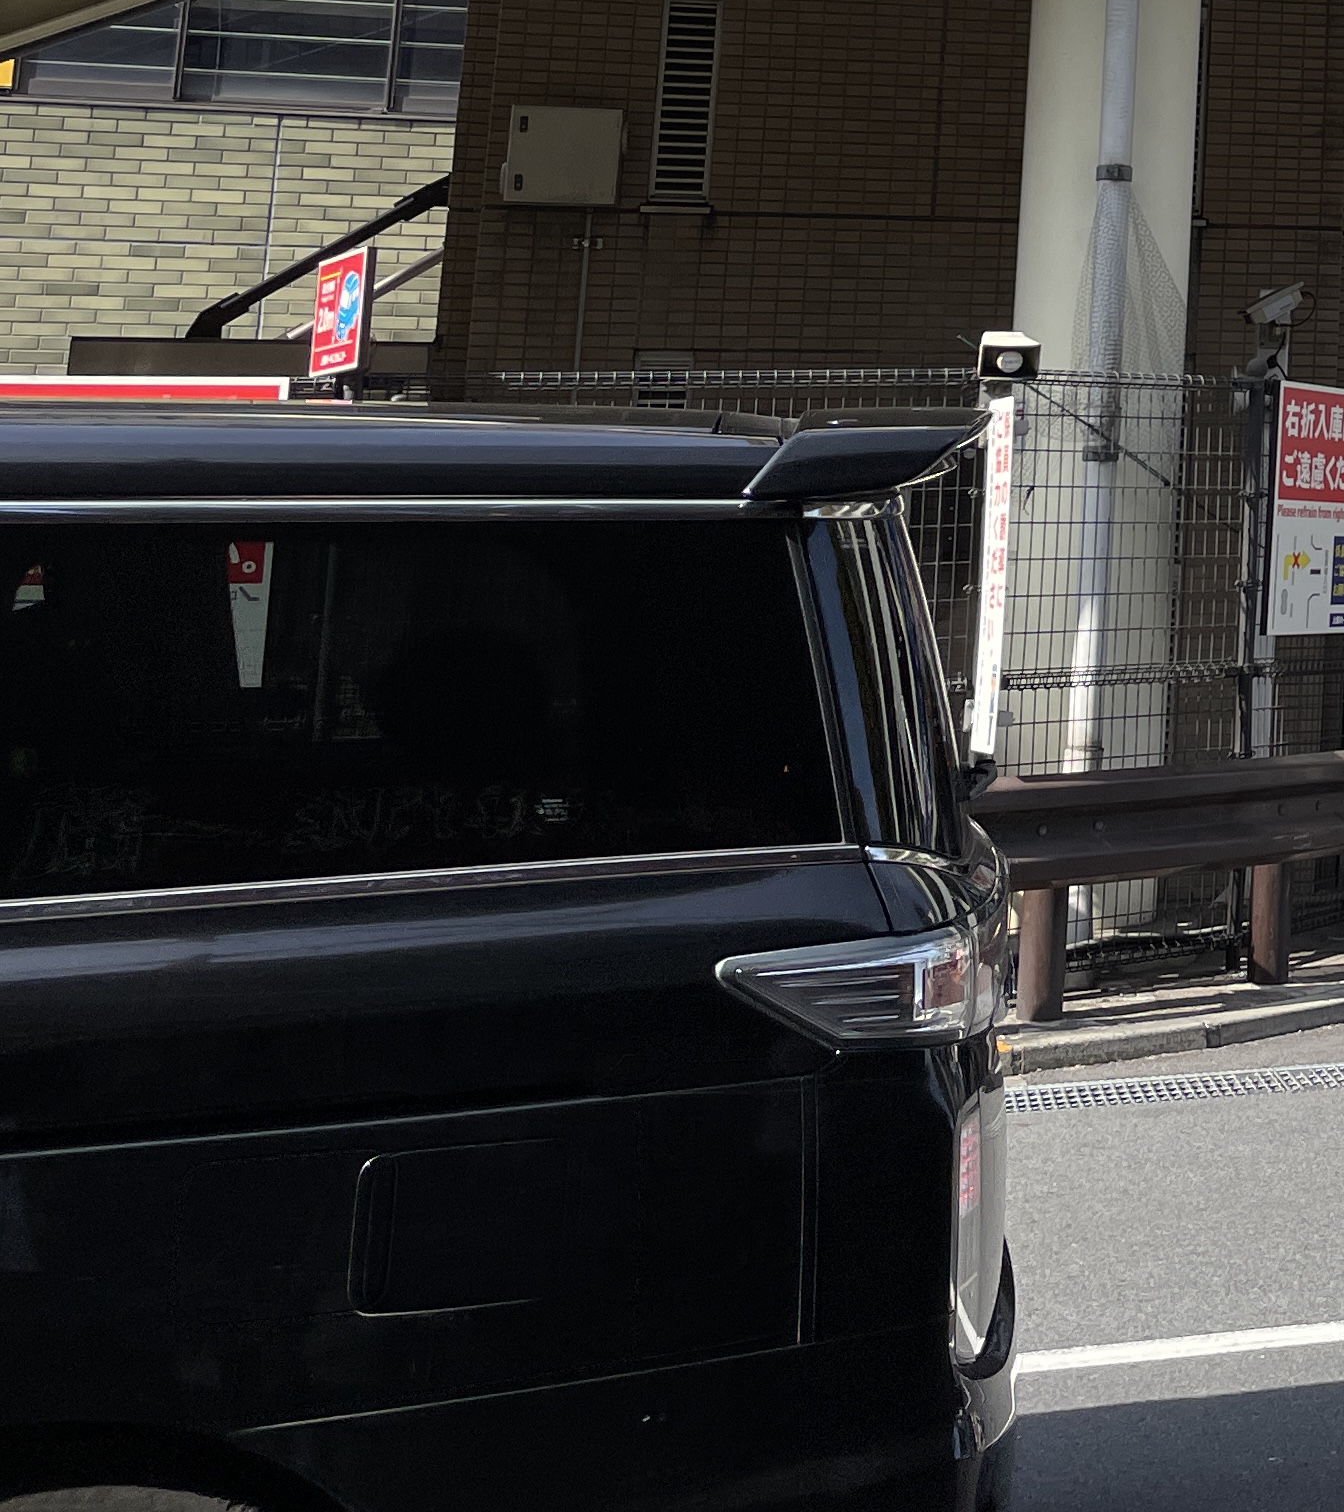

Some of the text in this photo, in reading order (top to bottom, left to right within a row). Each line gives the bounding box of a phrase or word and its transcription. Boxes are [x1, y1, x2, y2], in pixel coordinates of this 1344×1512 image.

[1277, 504, 1297, 517] Please
[1297, 504, 1317, 518] refrain
[1318, 506, 1332, 518] from
